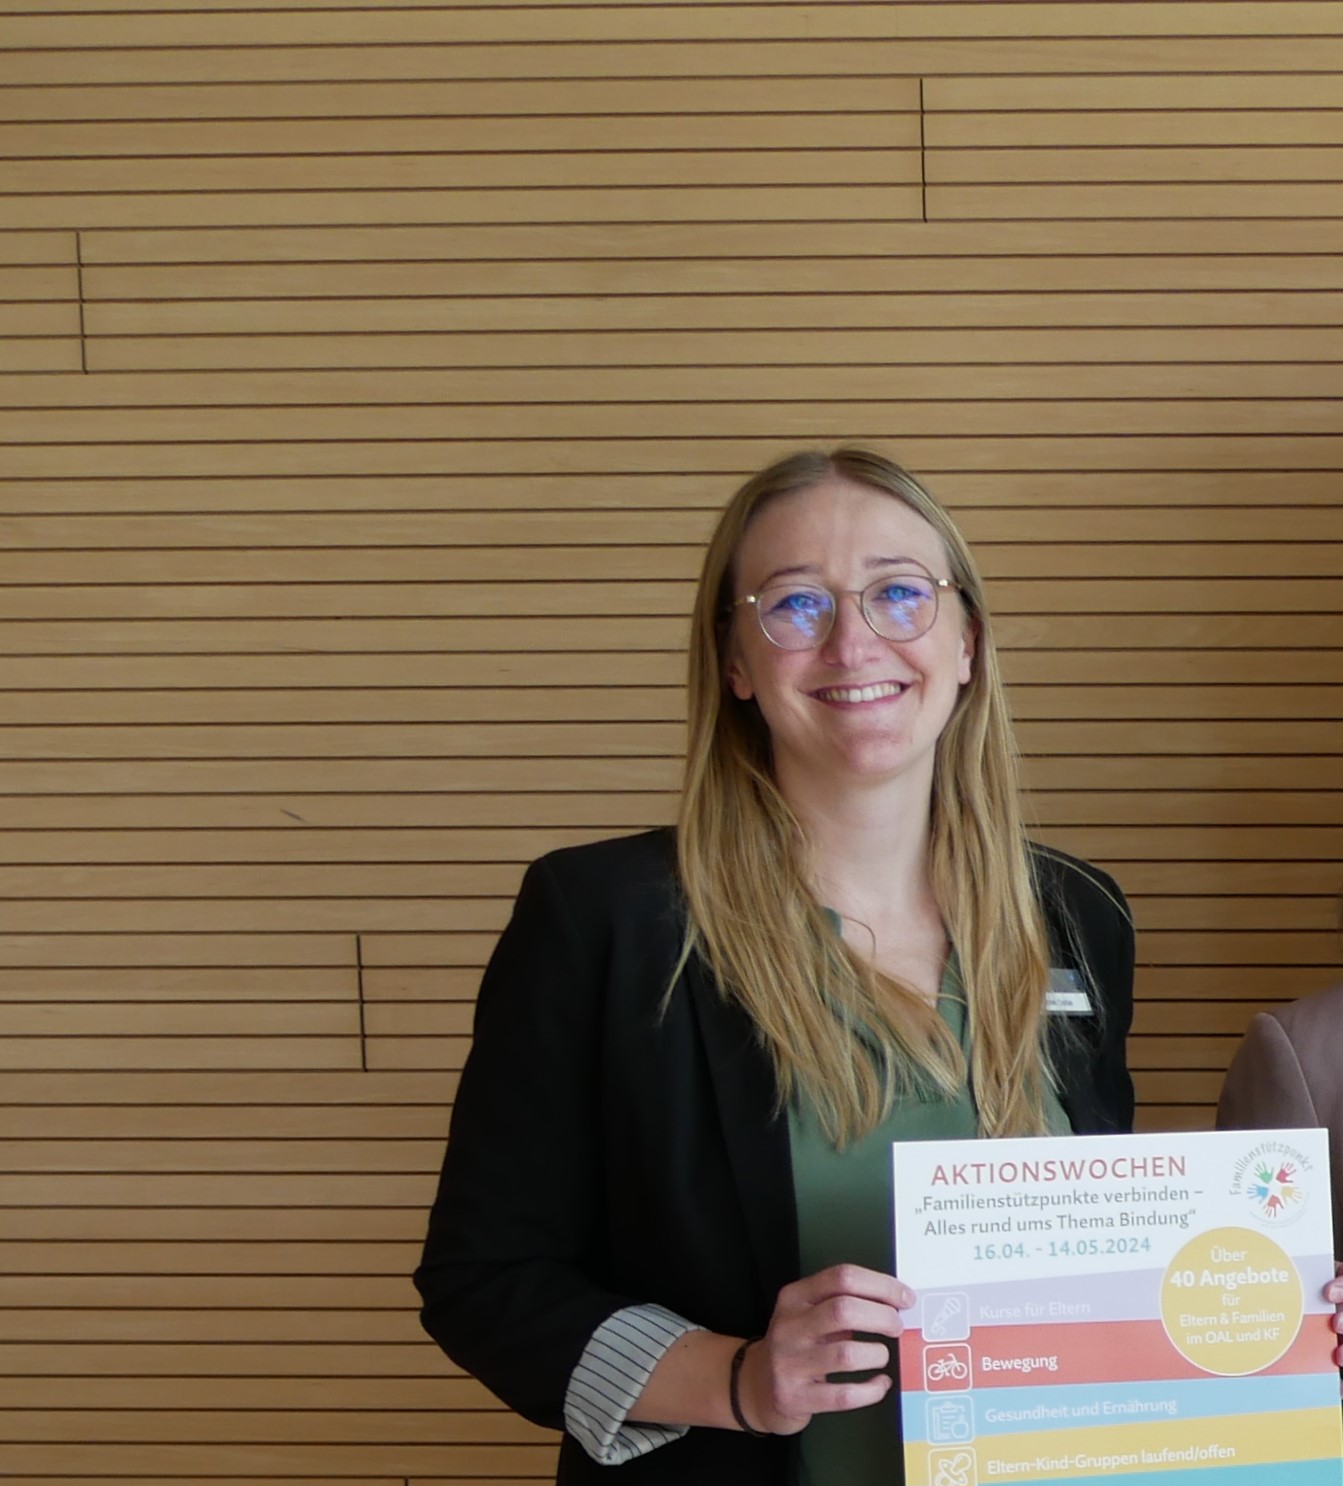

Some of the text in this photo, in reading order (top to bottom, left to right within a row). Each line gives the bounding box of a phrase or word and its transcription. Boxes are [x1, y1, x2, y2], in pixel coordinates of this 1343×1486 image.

[931, 1156, 1186, 1186] AKTIONSWOCHEN
[1104, 1186, 1189, 1206] verbinden
[924, 1213, 1114, 1236] Alles rund ums Thema
[974, 1237, 1151, 1260] 16.04. 14.05.2024
[1211, 1245, 1248, 1262] Über
[1170, 1267, 1289, 1289] 40 Angebote
[980, 1300, 1091, 1319] Kurse Eltern
[1180, 1309, 1285, 1327] Eltern Familien
[1205, 1330, 1233, 1344] OAL
[982, 1354, 1058, 1372] Bewegung
[986, 1398, 1177, 1423] Gesundheit und Ernährung
[987, 1444, 1236, 1476] Eltern-Kind-Gruppen laufend/offen
